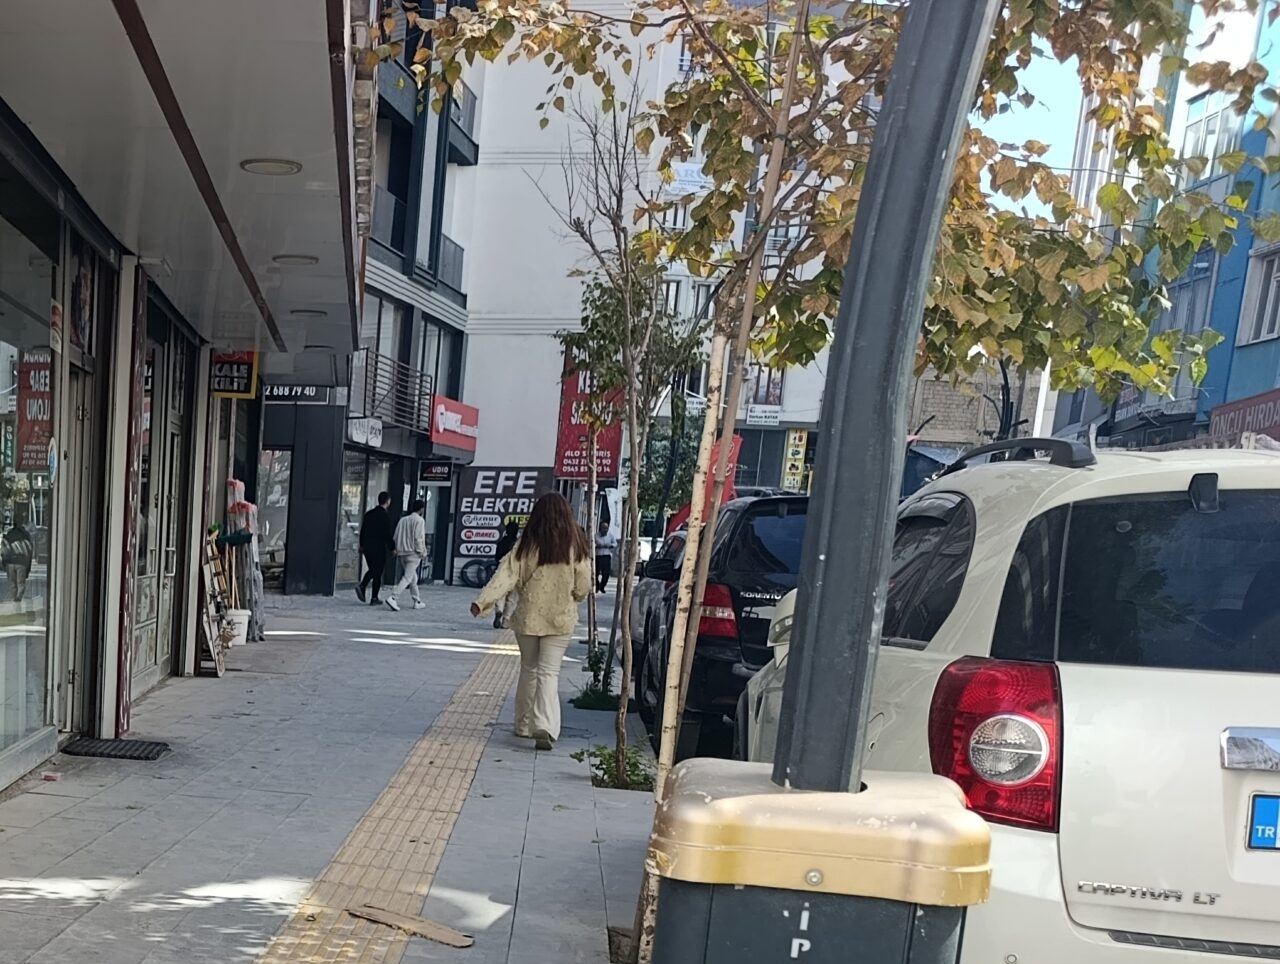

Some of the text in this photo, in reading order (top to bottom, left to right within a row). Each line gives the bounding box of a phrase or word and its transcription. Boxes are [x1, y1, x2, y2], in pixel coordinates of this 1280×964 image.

[304, 386, 316, 396] 40
[473, 470, 539, 494] EFE
[460, 497, 538, 513] ELEKTRİ
[1255, 825, 1276, 839] TR
[1077, 881, 1221, 906] CAPTIVA LT
